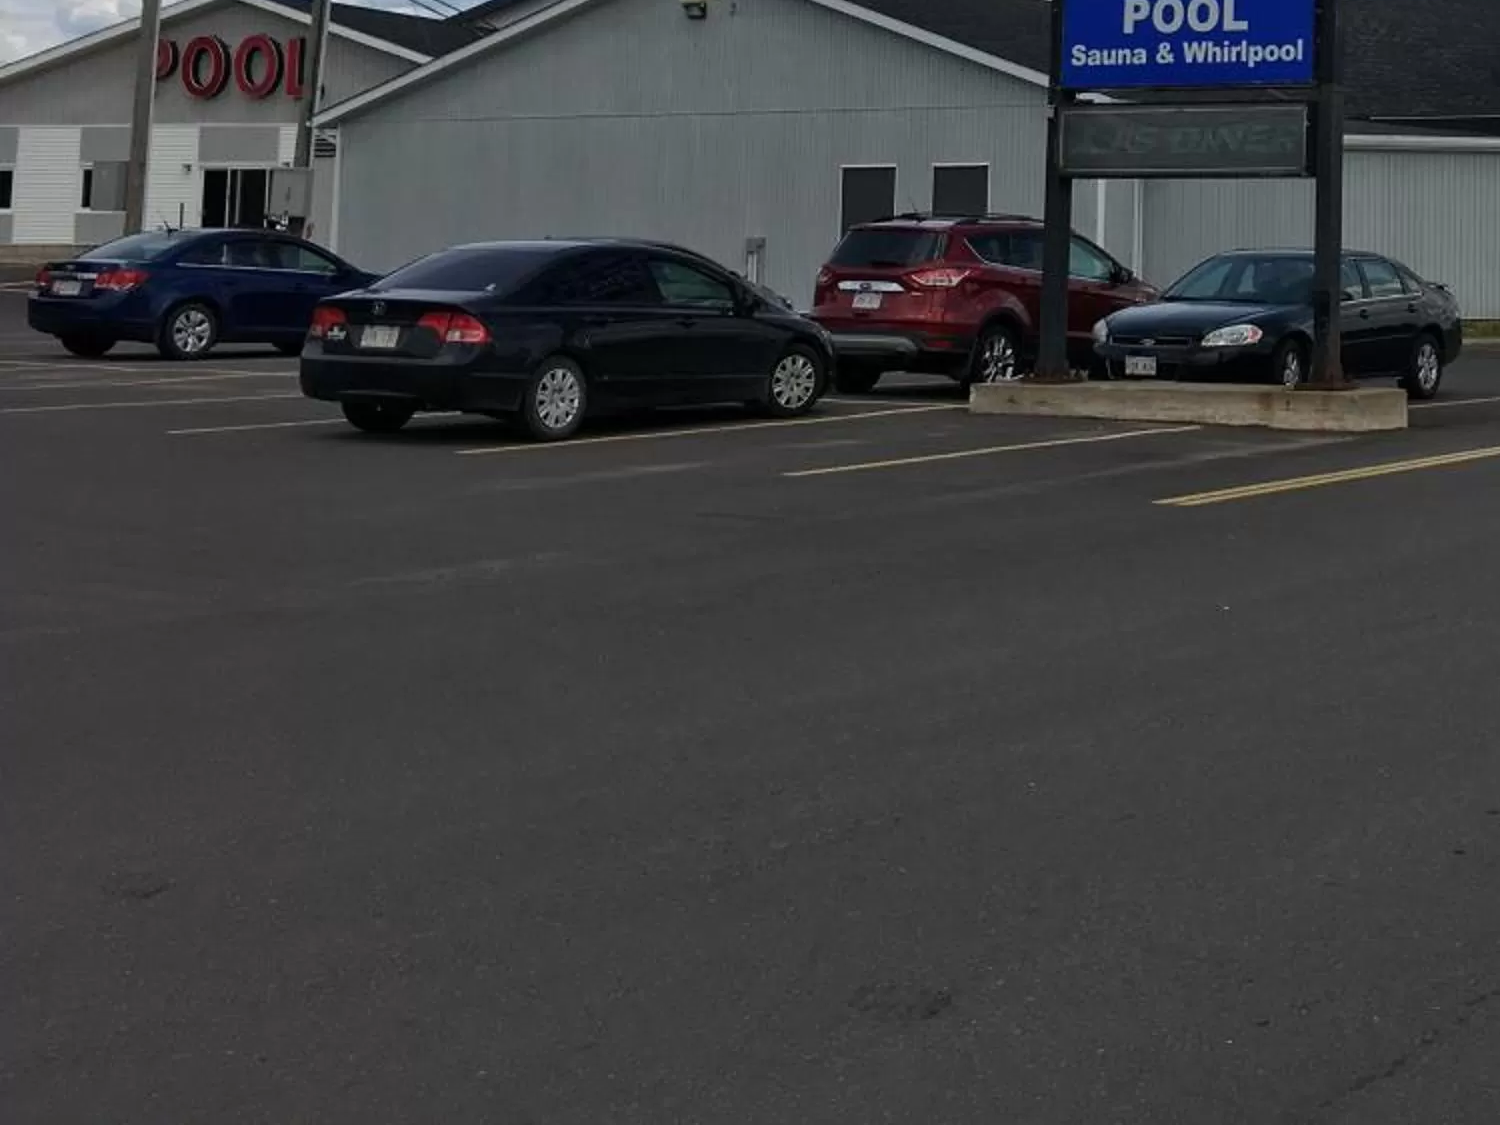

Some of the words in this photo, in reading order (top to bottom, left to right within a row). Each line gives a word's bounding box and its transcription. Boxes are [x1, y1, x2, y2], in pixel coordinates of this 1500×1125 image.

[1071, 44, 1148, 67] Sauna
[1155, 41, 1175, 64] &
[1182, 38, 1304, 68] Whirlpool
